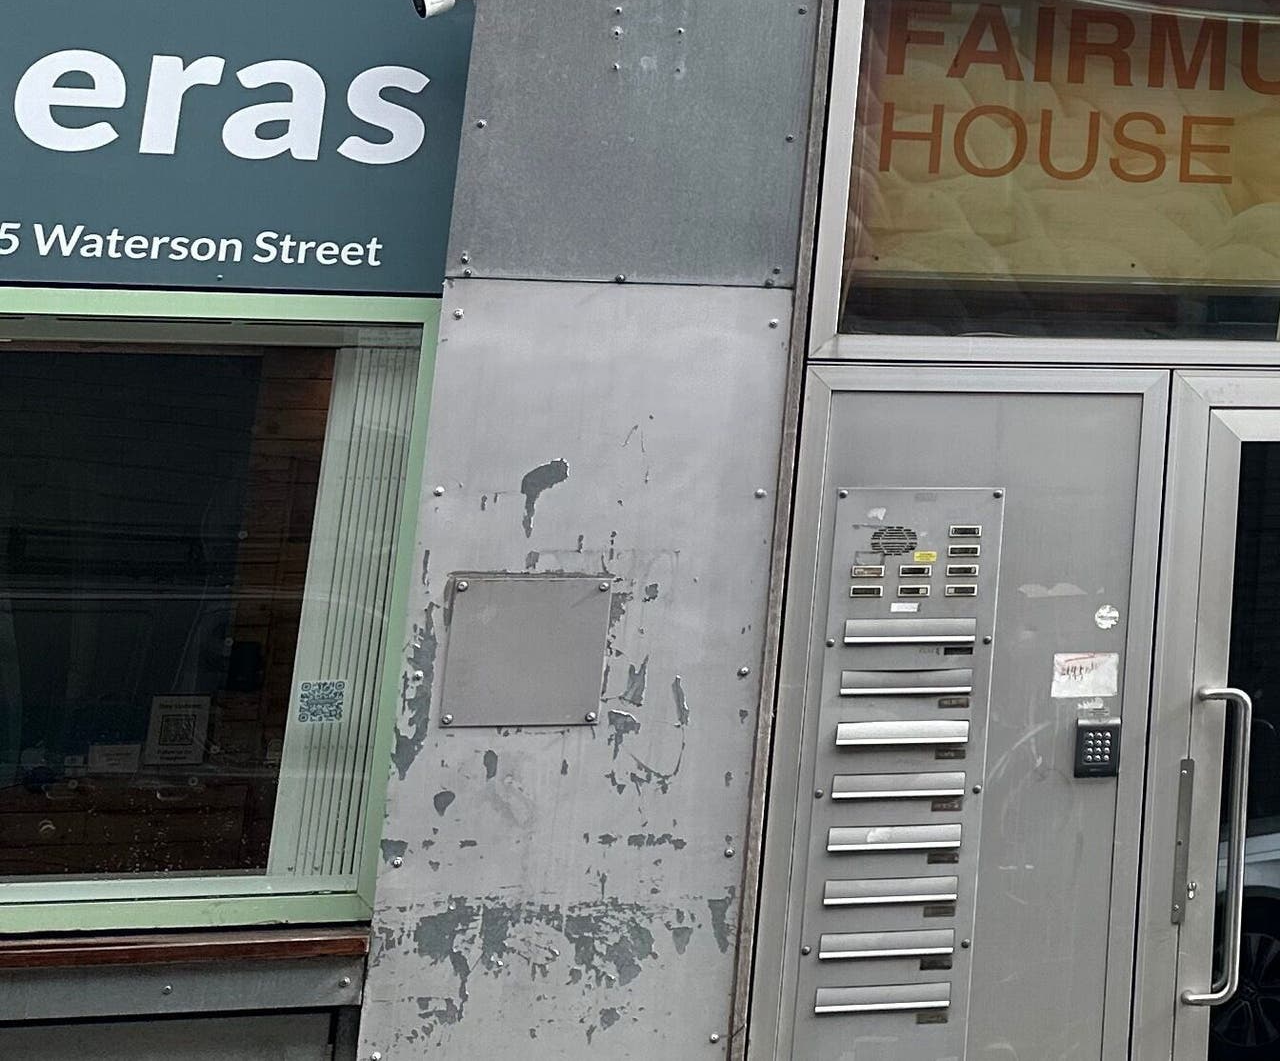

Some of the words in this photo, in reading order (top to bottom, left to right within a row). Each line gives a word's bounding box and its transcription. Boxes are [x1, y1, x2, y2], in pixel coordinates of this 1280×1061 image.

[14, 48, 431, 165] eras
[878, 103, 1236, 186] HOUSE
[34, 224, 242, 263] Waterson
[253, 231, 383, 267] Street
